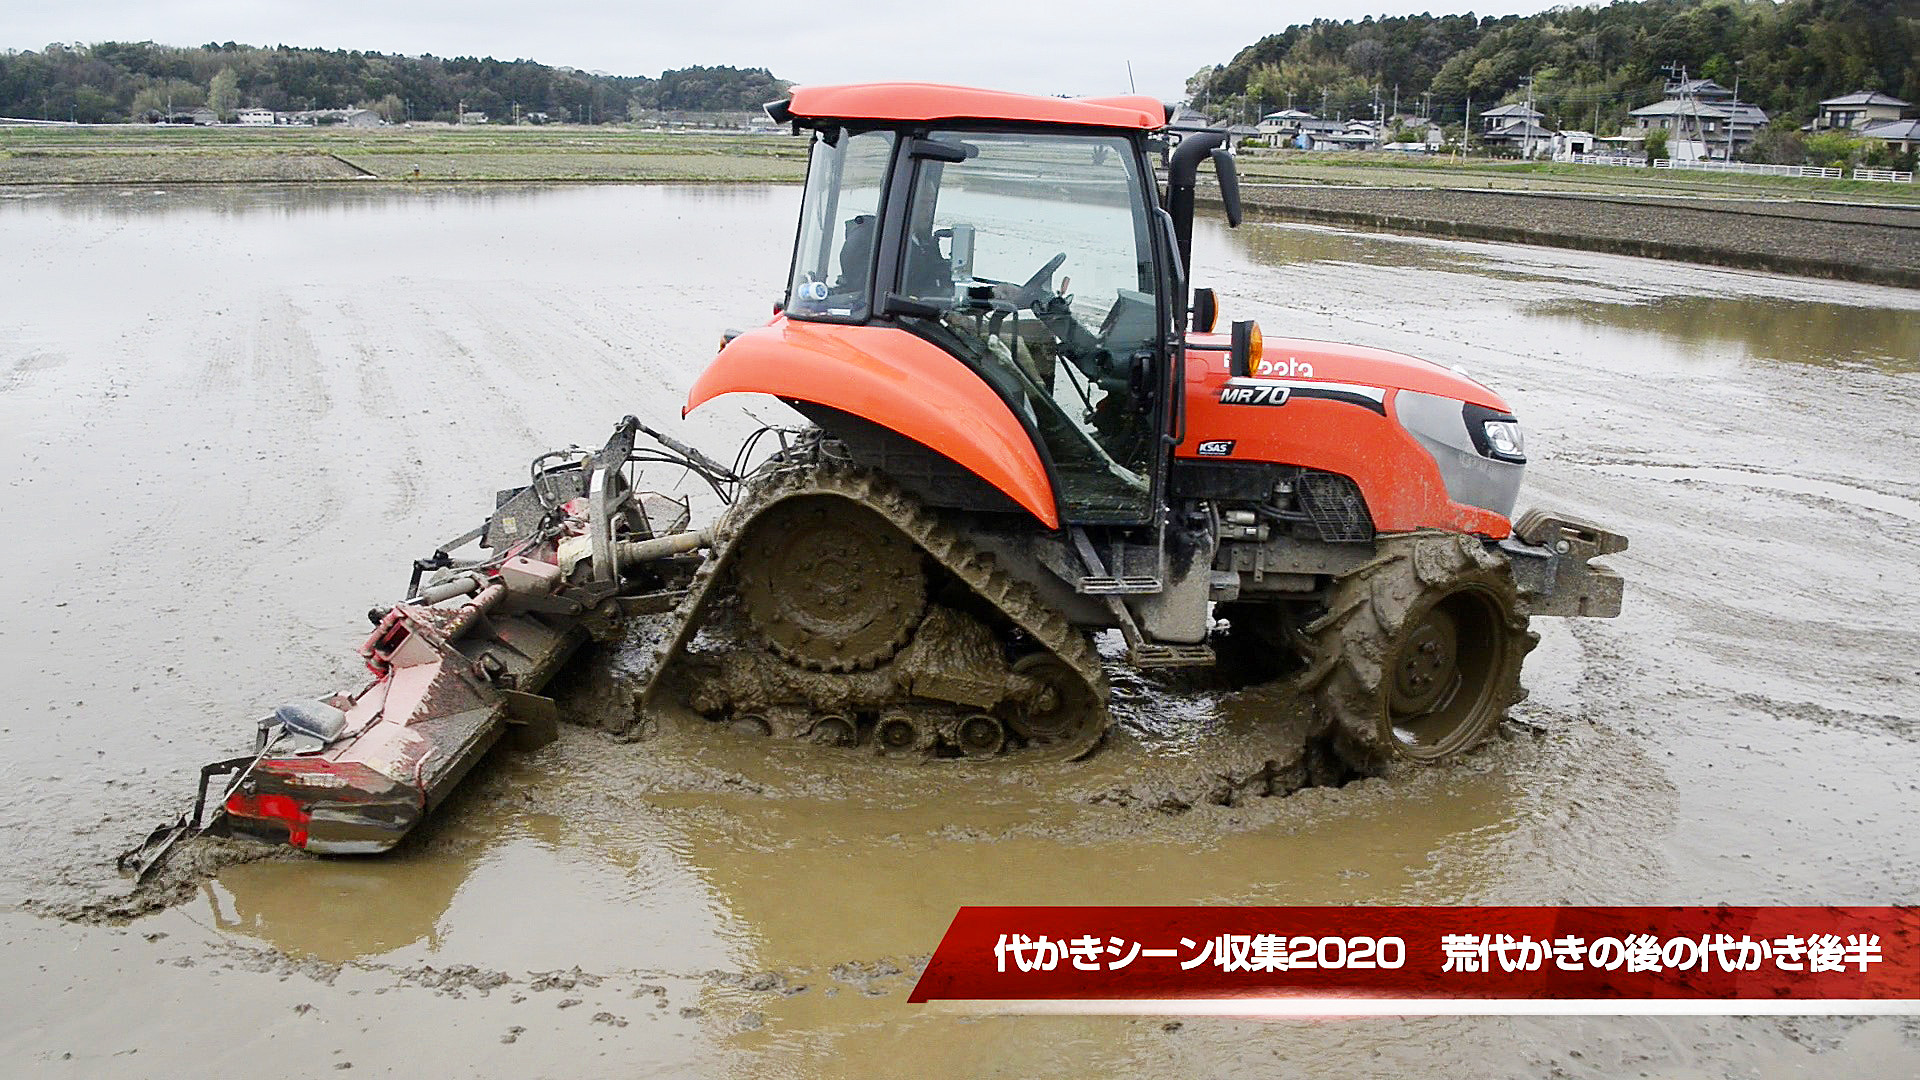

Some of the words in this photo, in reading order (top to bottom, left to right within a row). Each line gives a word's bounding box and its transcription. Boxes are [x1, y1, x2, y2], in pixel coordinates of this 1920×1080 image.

[1223, 353, 1313, 377] bota
[1220, 386, 1291, 405] MR70
[1199, 443, 1227, 452] KSAS
